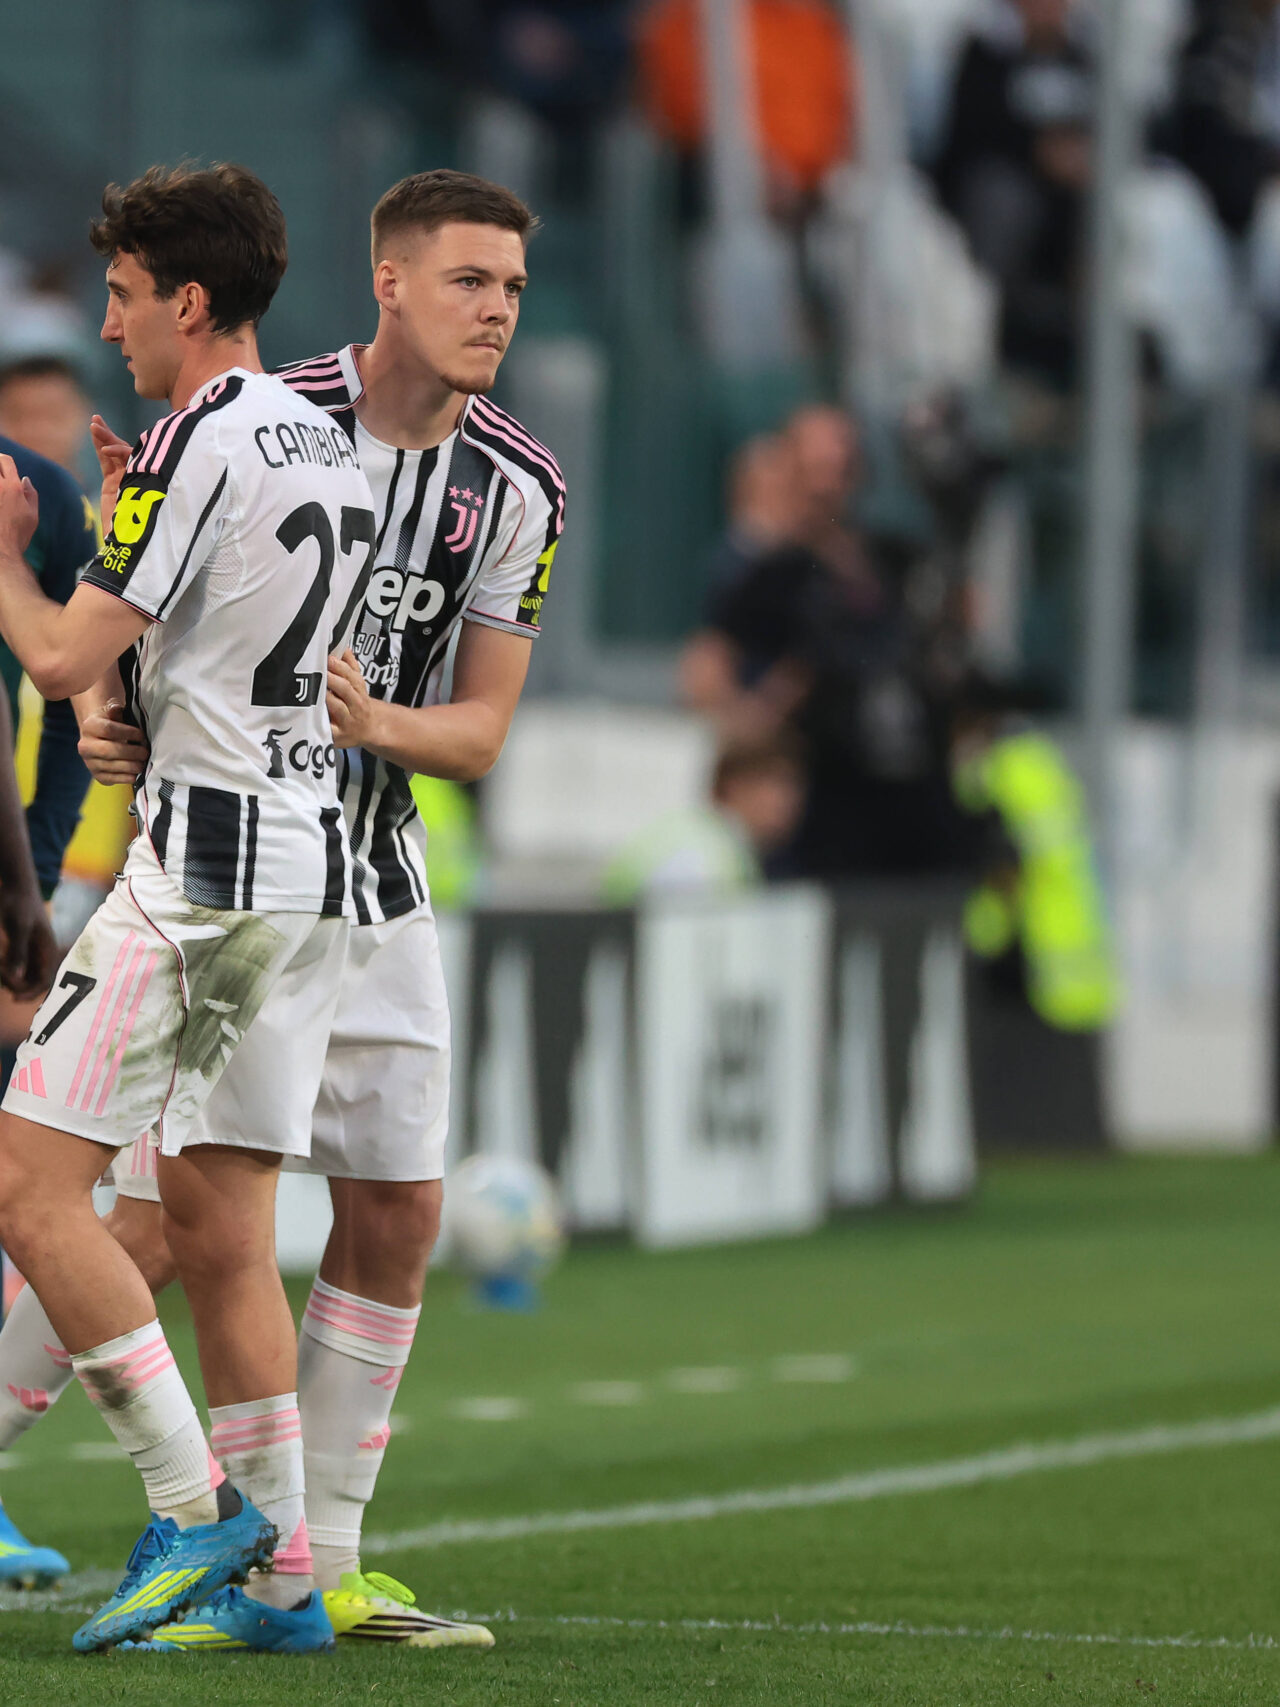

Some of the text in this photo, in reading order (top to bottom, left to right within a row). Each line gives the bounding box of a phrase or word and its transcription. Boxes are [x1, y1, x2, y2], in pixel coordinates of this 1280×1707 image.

[251, 501, 376, 706] 27
[365, 568, 446, 631] ep
[26, 970, 97, 1046] 7
